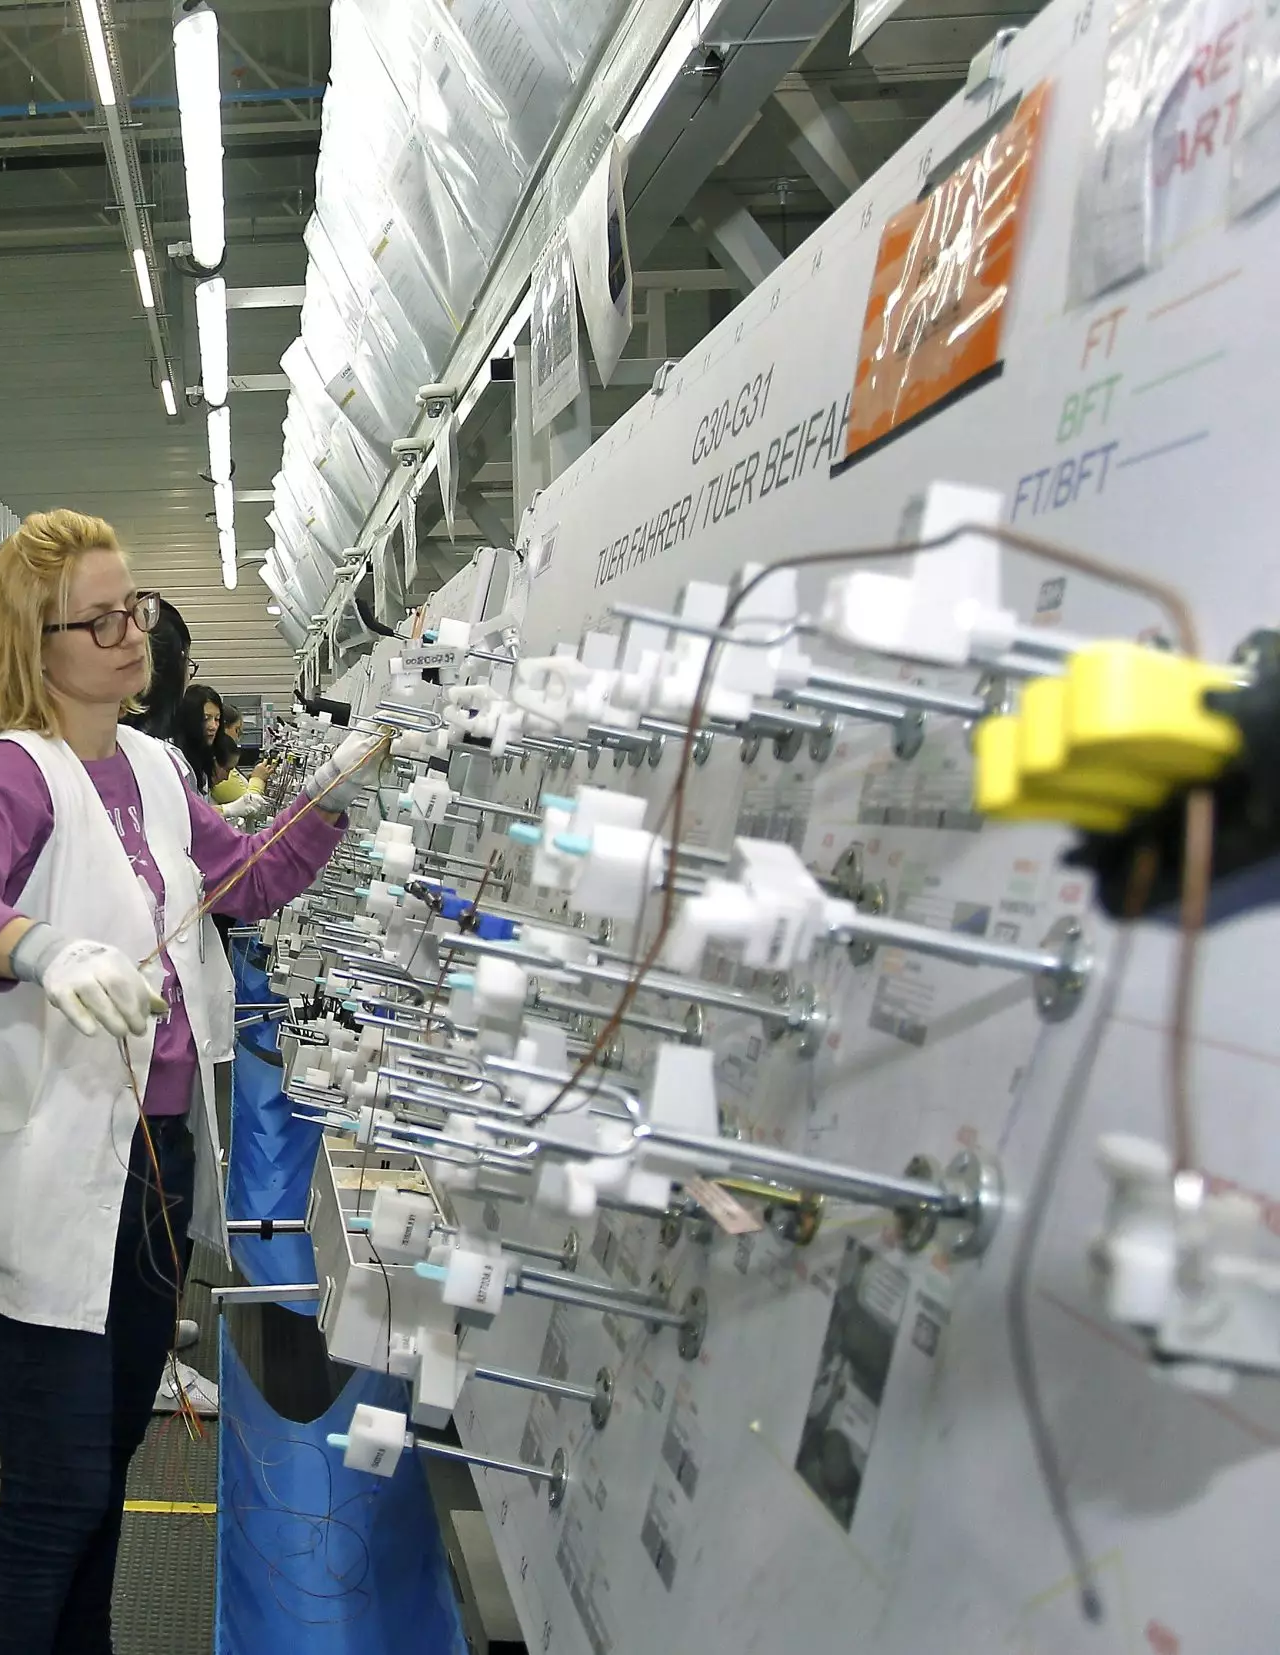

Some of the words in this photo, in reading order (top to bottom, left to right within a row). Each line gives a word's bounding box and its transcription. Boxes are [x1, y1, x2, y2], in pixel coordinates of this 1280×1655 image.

[1081, 306, 1128, 371] FT
[692, 362, 774, 465] G30-G31
[1056, 373, 1123, 444] BFT
[594, 534, 630, 589] TUER
[627, 494, 692, 572] FAHRER
[689, 485, 705, 538] /
[703, 451, 761, 529] TUER
[1011, 441, 1119, 524] FT/BFT
